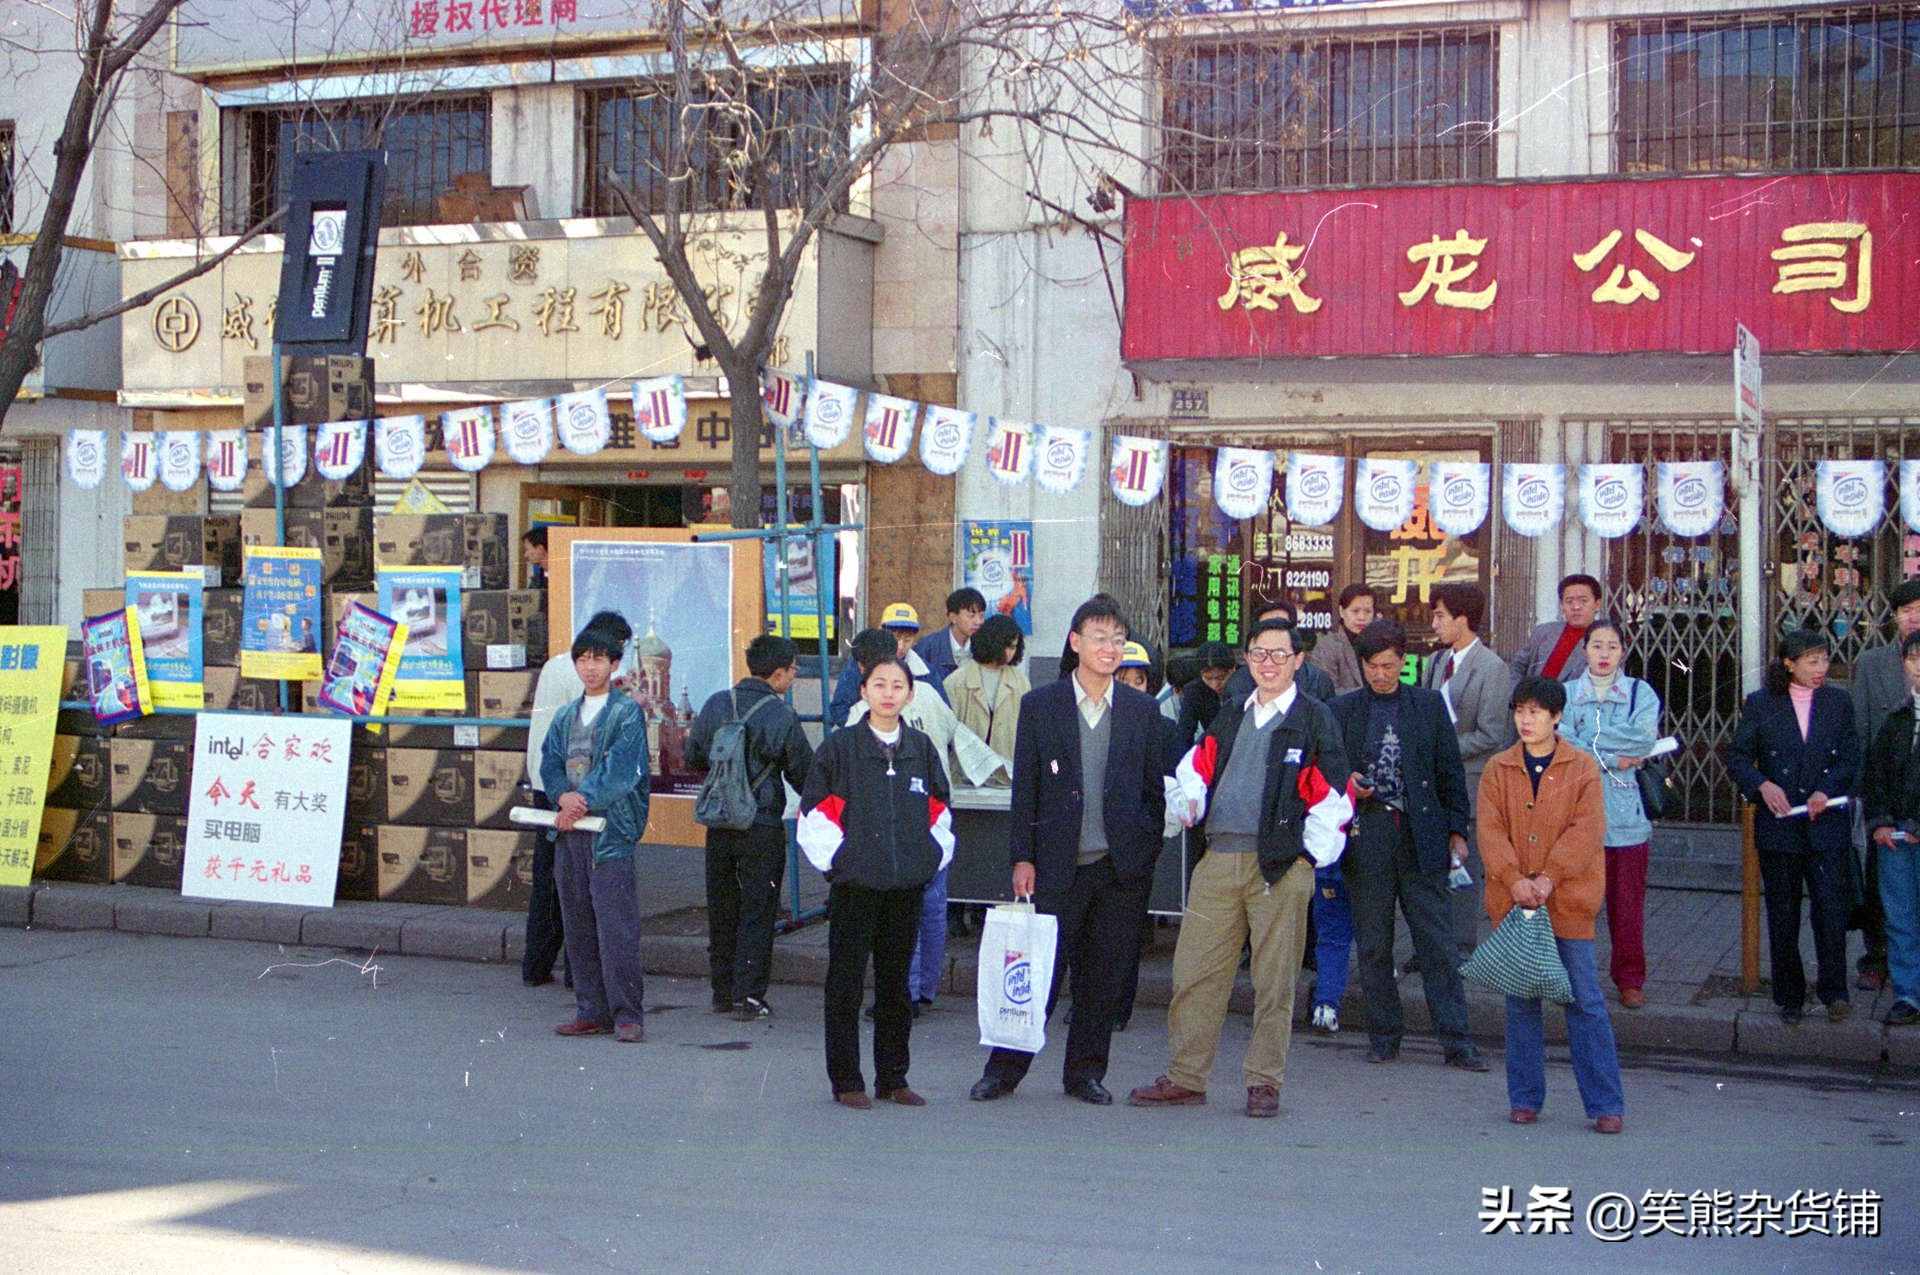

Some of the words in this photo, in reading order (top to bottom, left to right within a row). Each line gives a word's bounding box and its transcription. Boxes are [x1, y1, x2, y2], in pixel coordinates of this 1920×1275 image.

[410, 0, 577, 38] 授权代理商
[1217, 220, 1875, 313] 威龙公司
[311, 266, 333, 318] pentium
[1175, 400, 1202, 409] 257
[1285, 535, 1333, 551] 8683333
[1286, 571, 1329, 587] 8221190
[1207, 554, 1221, 642] 家用电器
[1226, 554, 1240, 644] 通讯设备
[1297, 612, 1332, 629] 28108
[208, 735, 245, 760] intel
[253, 732, 333, 763] 合家欢
[205, 776, 260, 810] 今天
[274, 790, 328, 813] 有大奖
[203, 819, 261, 843] 买电脑
[203, 855, 313, 884] 获千元礼品
[1007, 968, 1026, 985] intel
[1000, 1006, 1028, 1017] pentium
